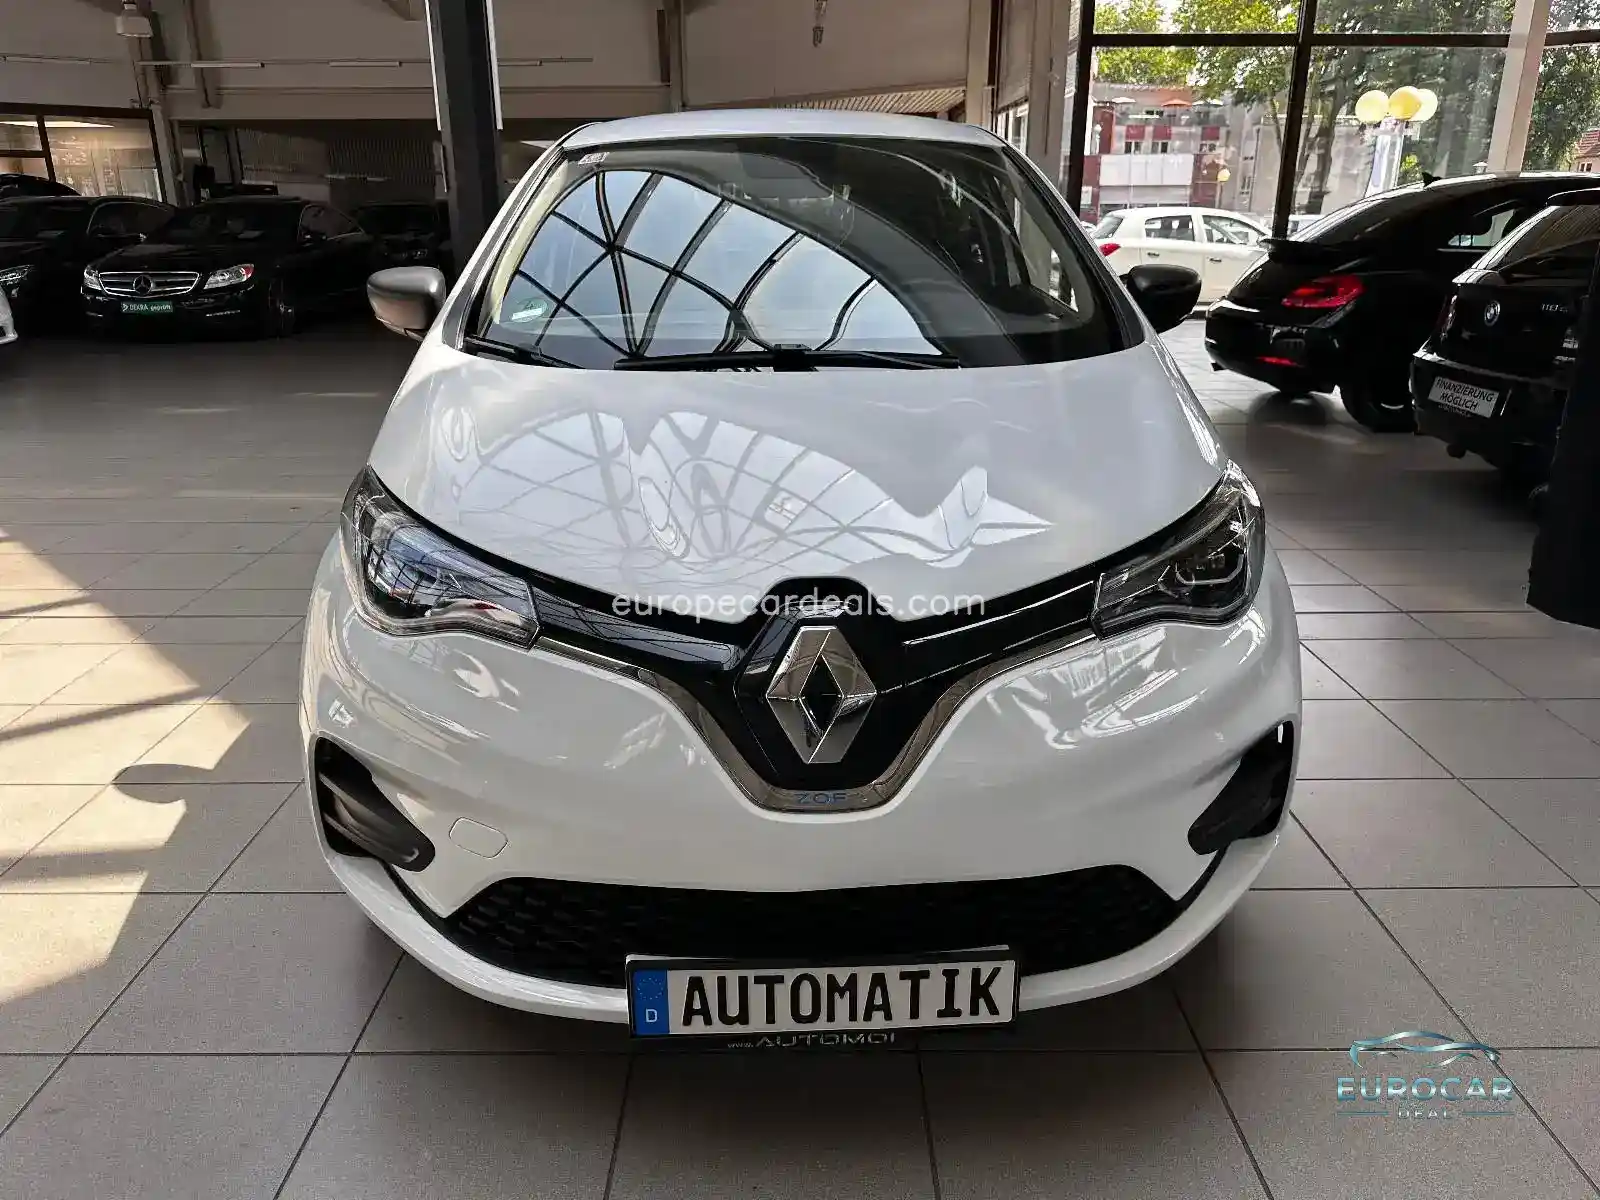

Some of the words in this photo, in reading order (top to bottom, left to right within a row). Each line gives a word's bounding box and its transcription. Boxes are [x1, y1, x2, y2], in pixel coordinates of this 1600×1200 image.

[1436, 378, 1495, 402] FINANZIERUNG
[1440, 392, 1479, 410] MÖGLICH
[681, 965, 1003, 1027] AUTOMATIK
[644, 1008, 658, 1023] D
